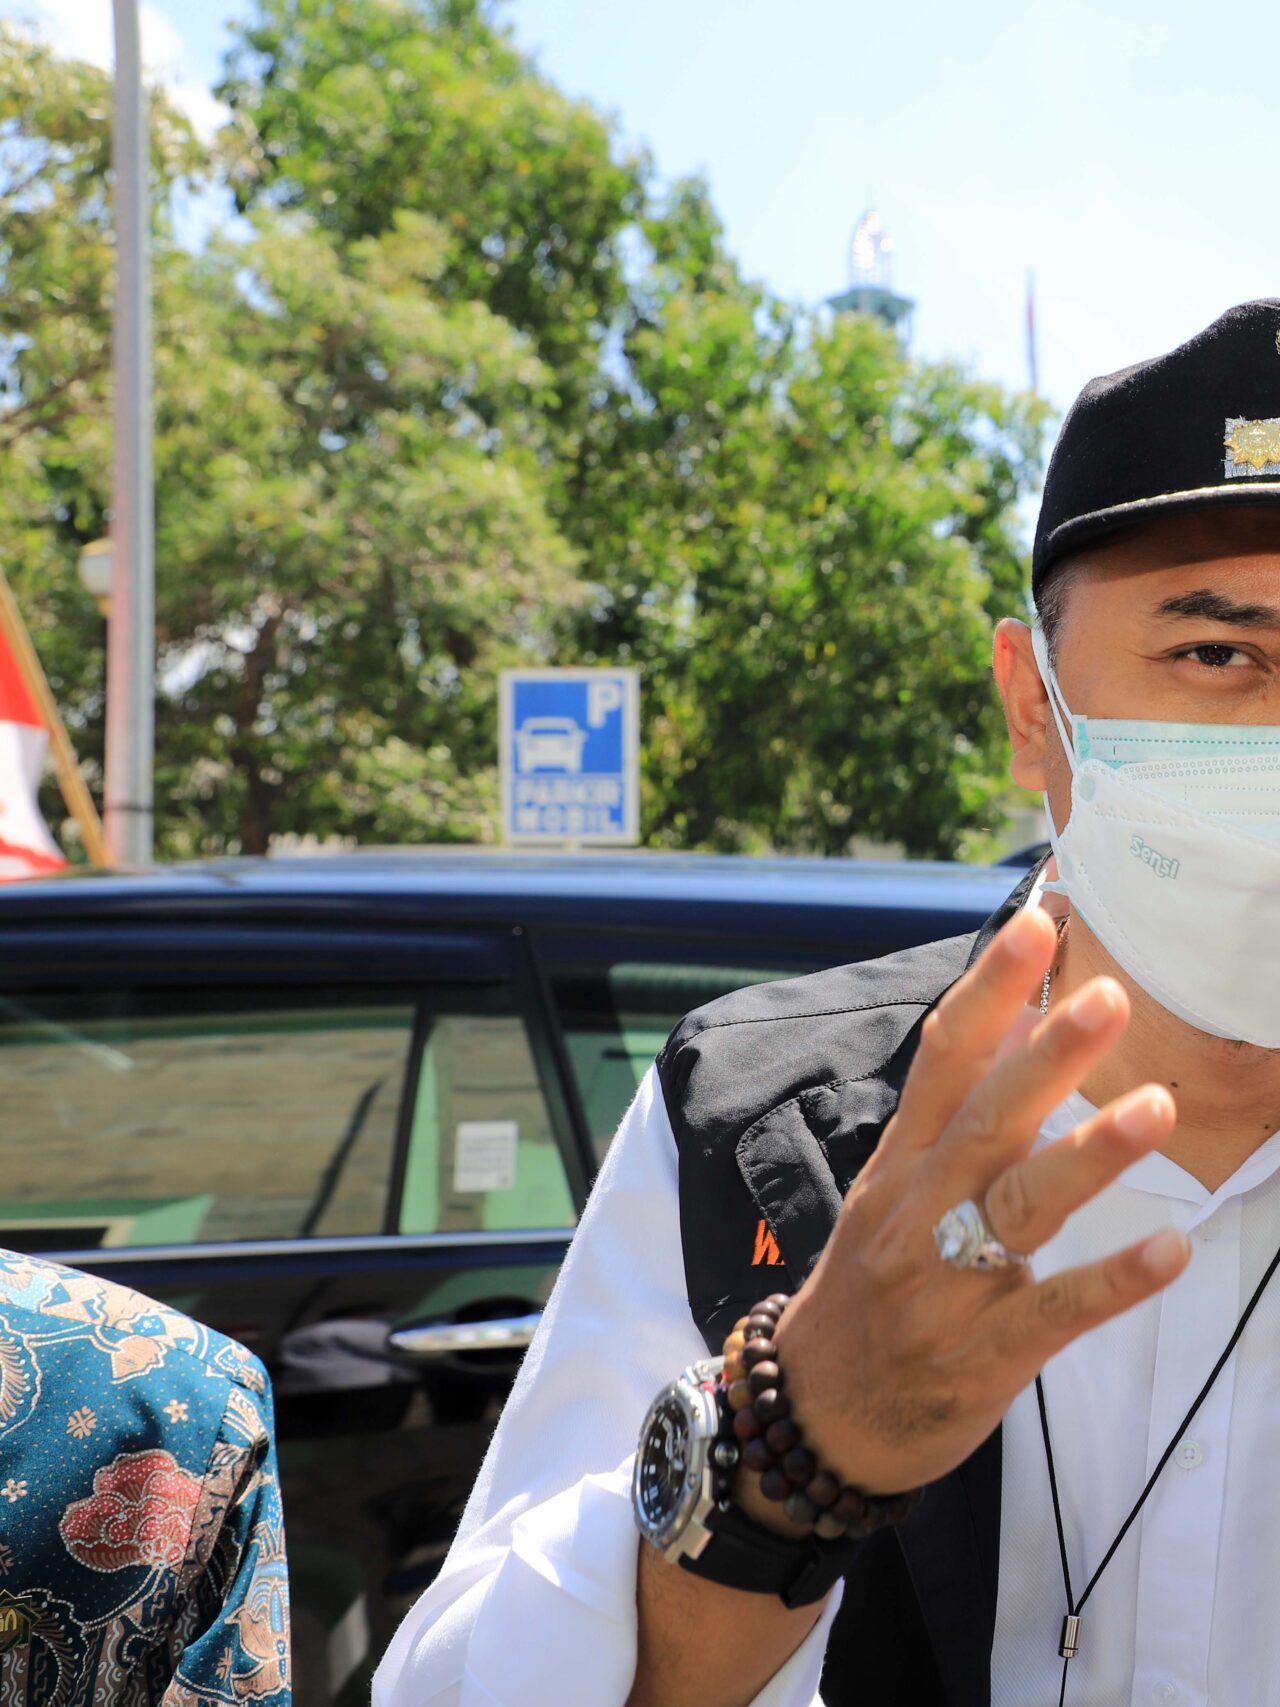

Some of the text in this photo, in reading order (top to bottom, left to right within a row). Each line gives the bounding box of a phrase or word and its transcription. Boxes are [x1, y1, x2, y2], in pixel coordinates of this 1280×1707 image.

[588, 682, 620, 727] P
[514, 779, 620, 803] PARKIR
[516, 807, 620, 833] MOBIL
[1130, 834, 1180, 880] Sensi
